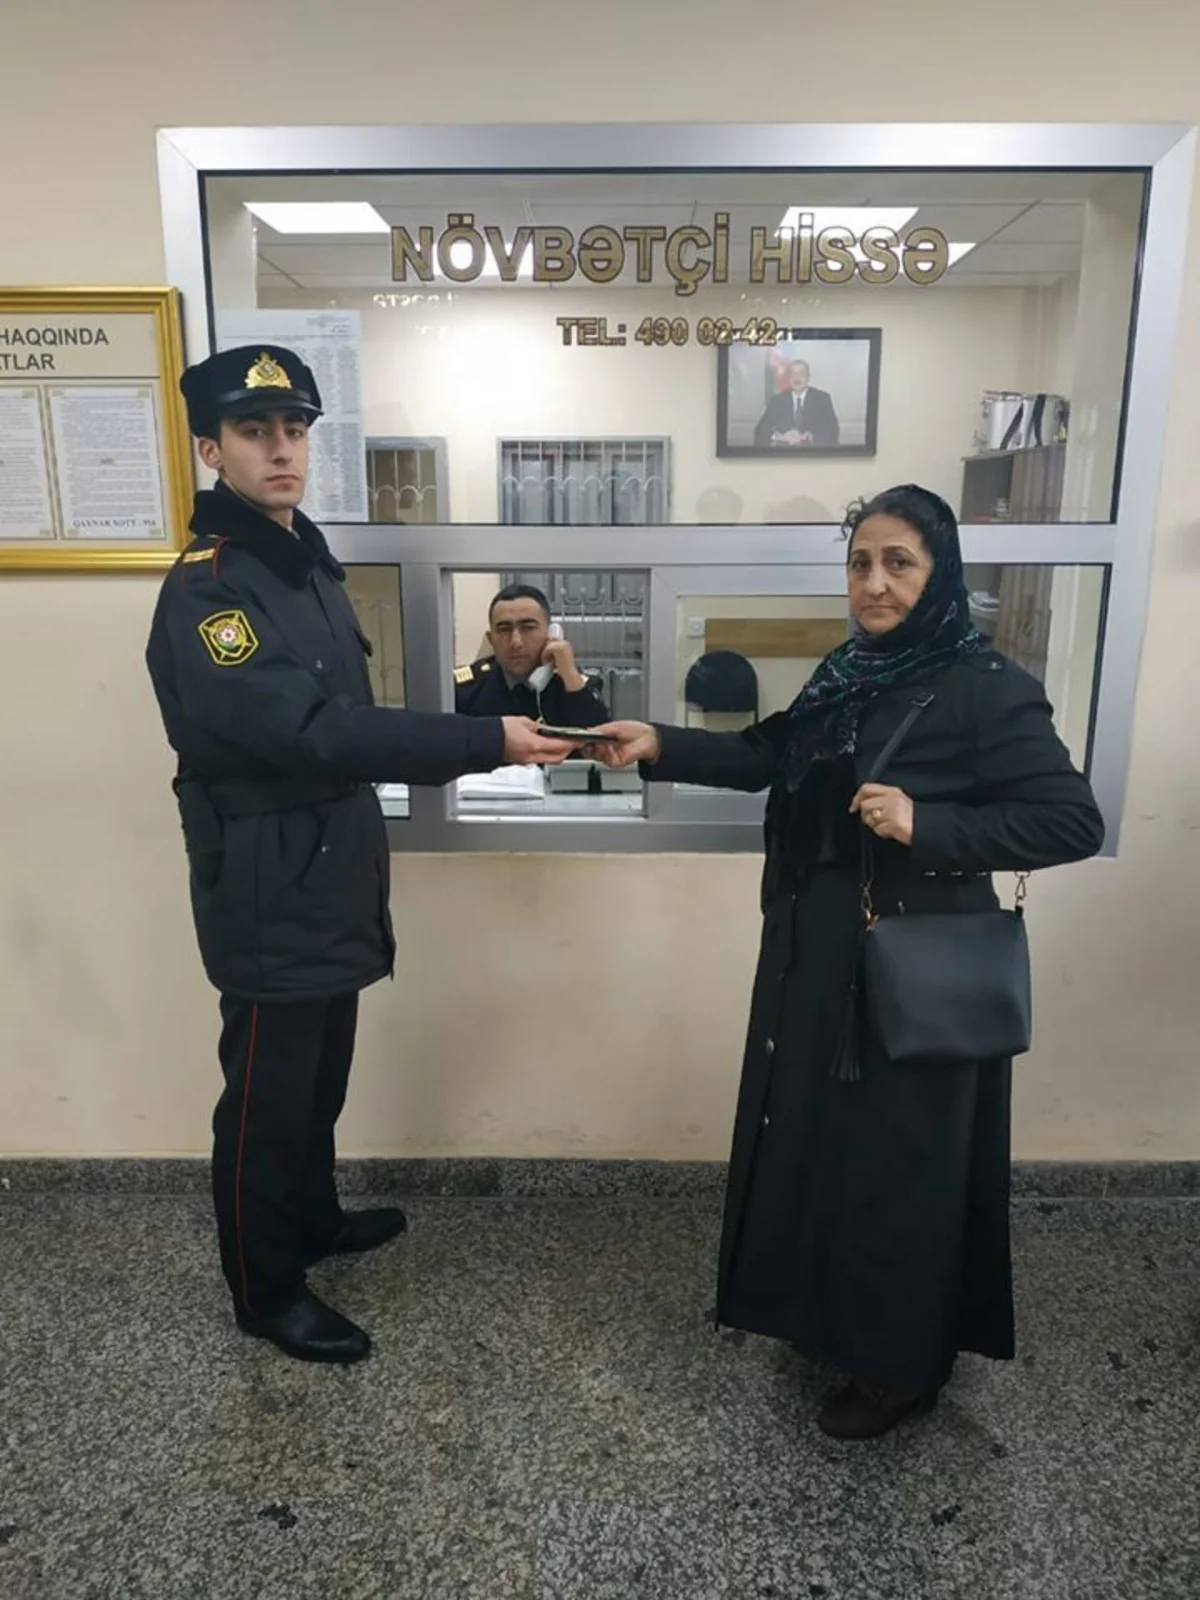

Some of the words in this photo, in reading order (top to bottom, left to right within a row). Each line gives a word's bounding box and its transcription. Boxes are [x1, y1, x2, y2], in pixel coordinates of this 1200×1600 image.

[390, 213, 729, 296] NÖVBƏTÇİ
[750, 212, 949, 285] HİSSƏ
[0, 327, 109, 347] HAQQINDA
[556, 317, 627, 346] TEL:
[635, 317, 689, 346] 490
[0, 353, 55, 371] TLAR
